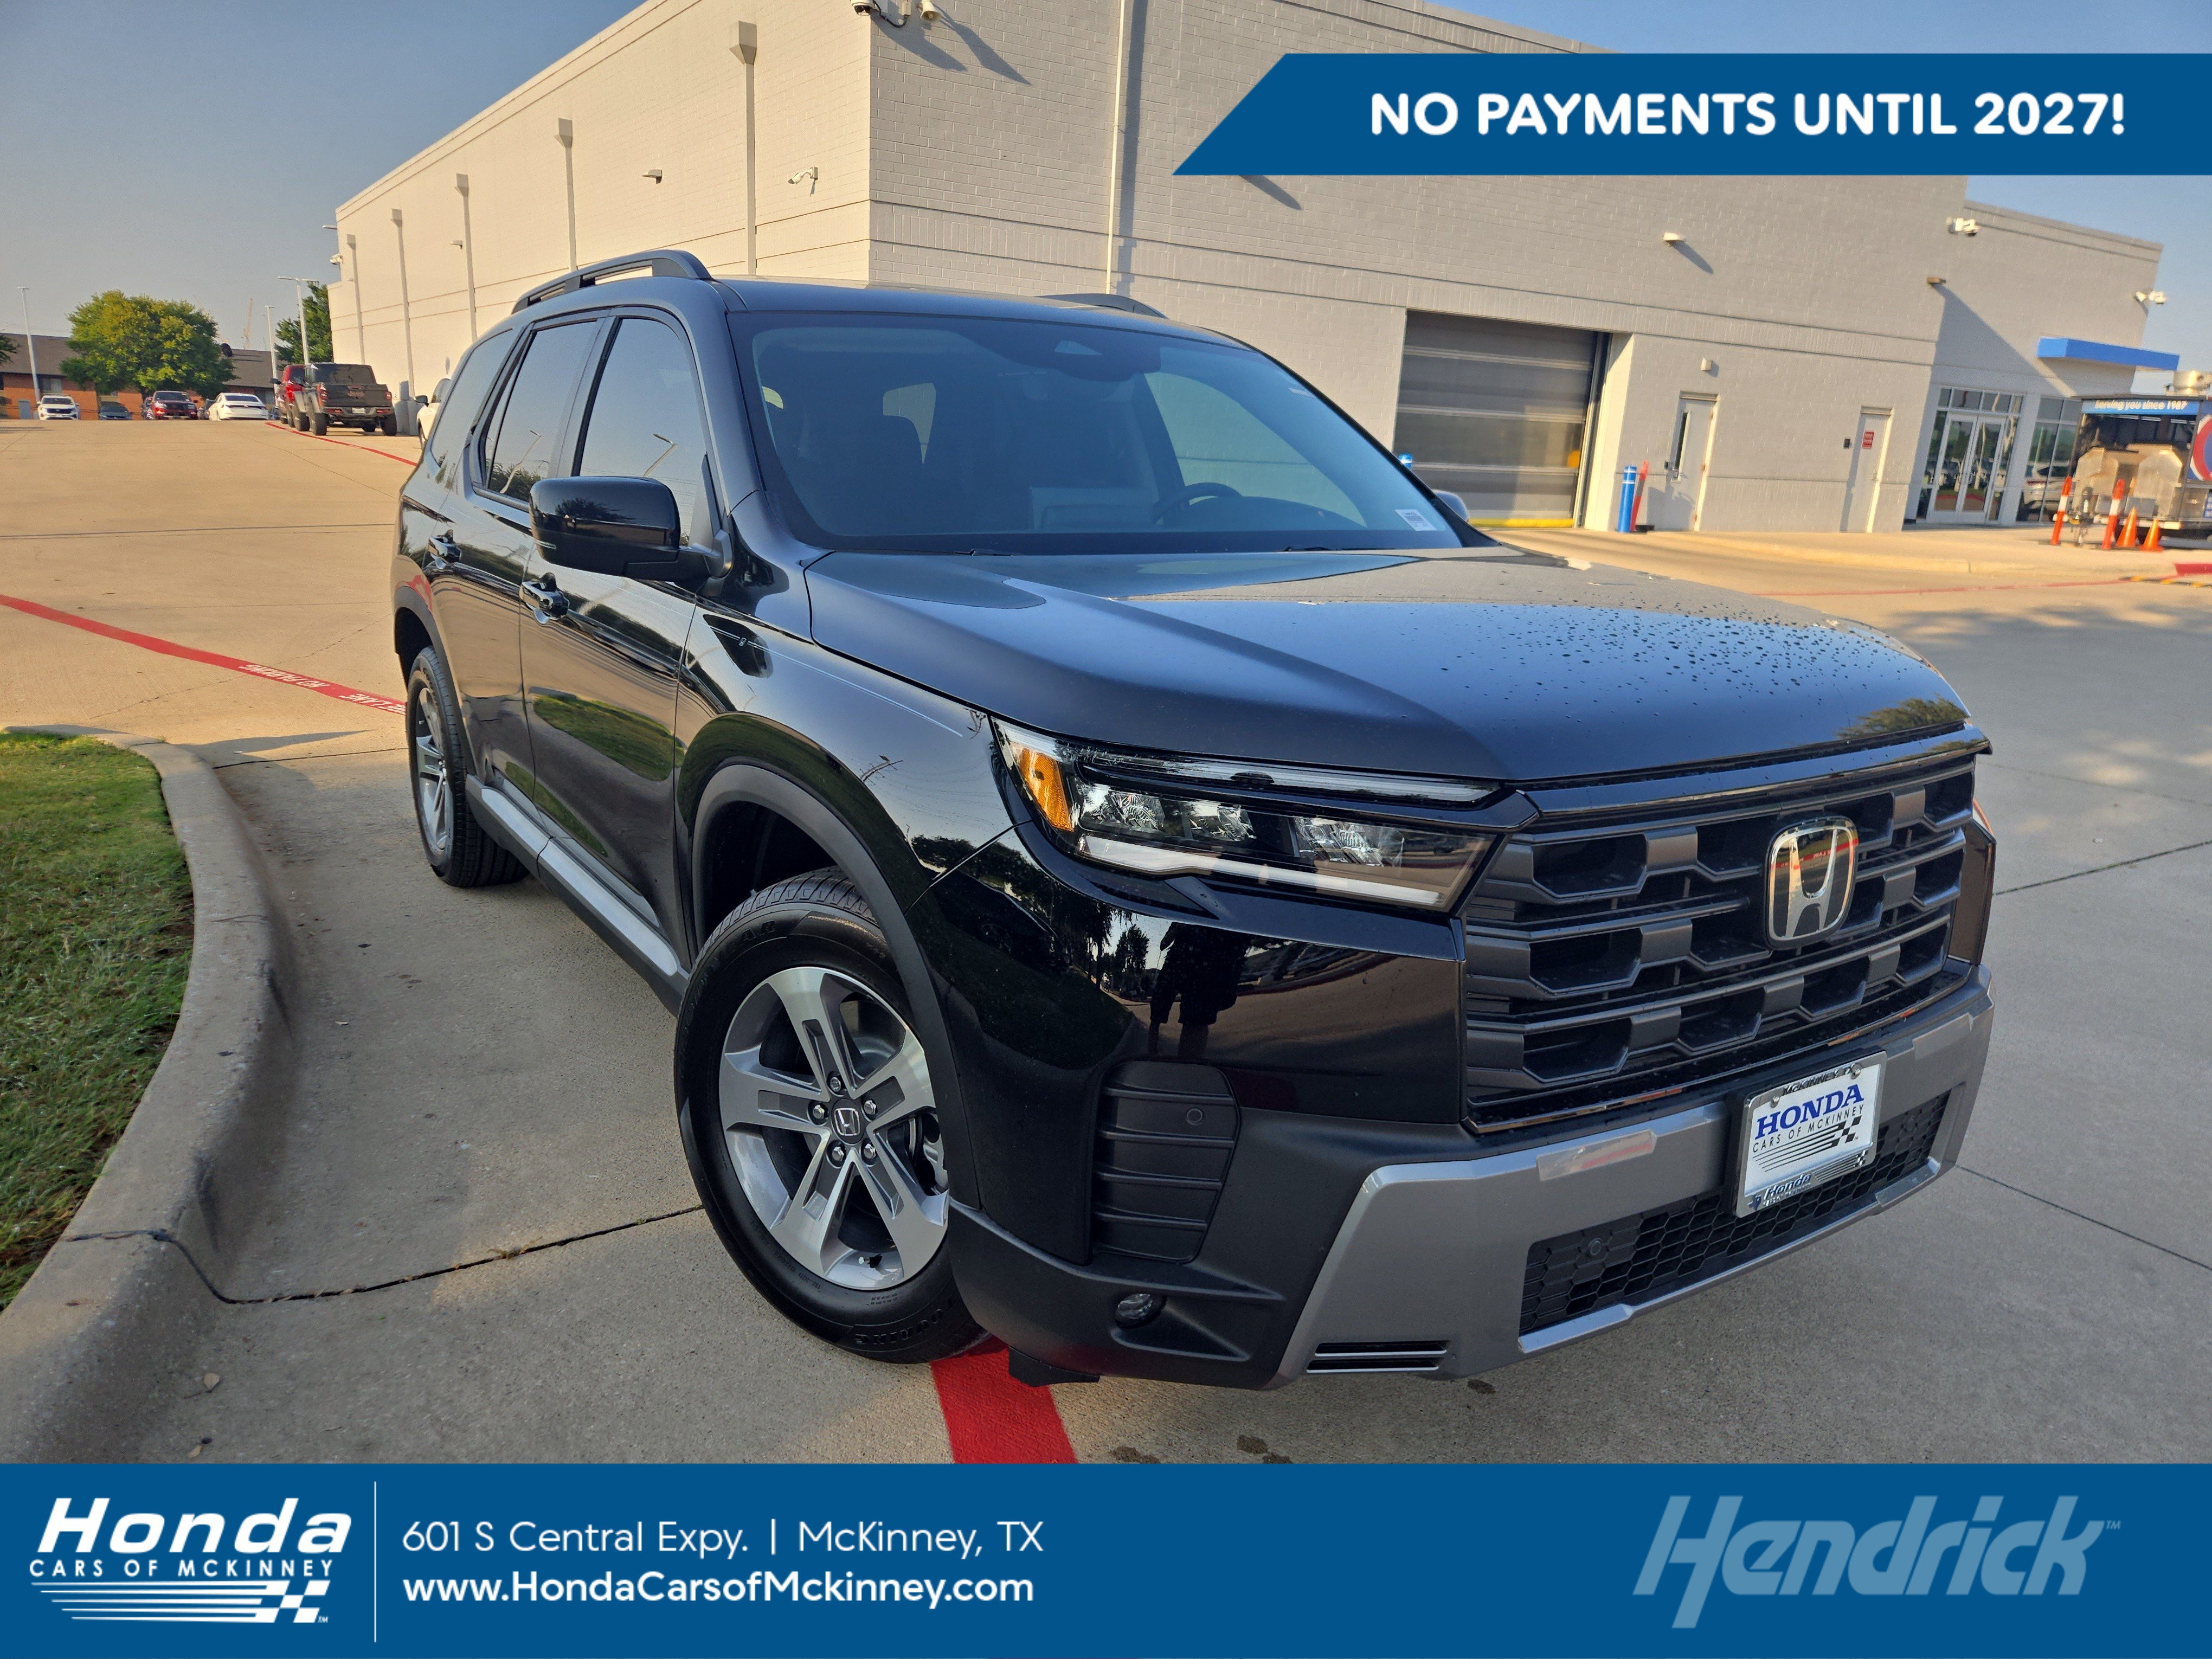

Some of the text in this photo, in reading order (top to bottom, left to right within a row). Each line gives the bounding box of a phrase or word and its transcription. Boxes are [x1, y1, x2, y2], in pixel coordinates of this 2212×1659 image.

[2125, 401, 2142, 410] you
[2142, 400, 2165, 410] since
[2167, 401, 2188, 410] 1987
[238, 664, 303, 682] PARKING
[296, 679, 330, 688] NO
[338, 693, 391, 706] LANE
[1754, 1084, 1864, 1140] HONDA
[1752, 1104, 1864, 1153] CARS OF MCKINNEY
